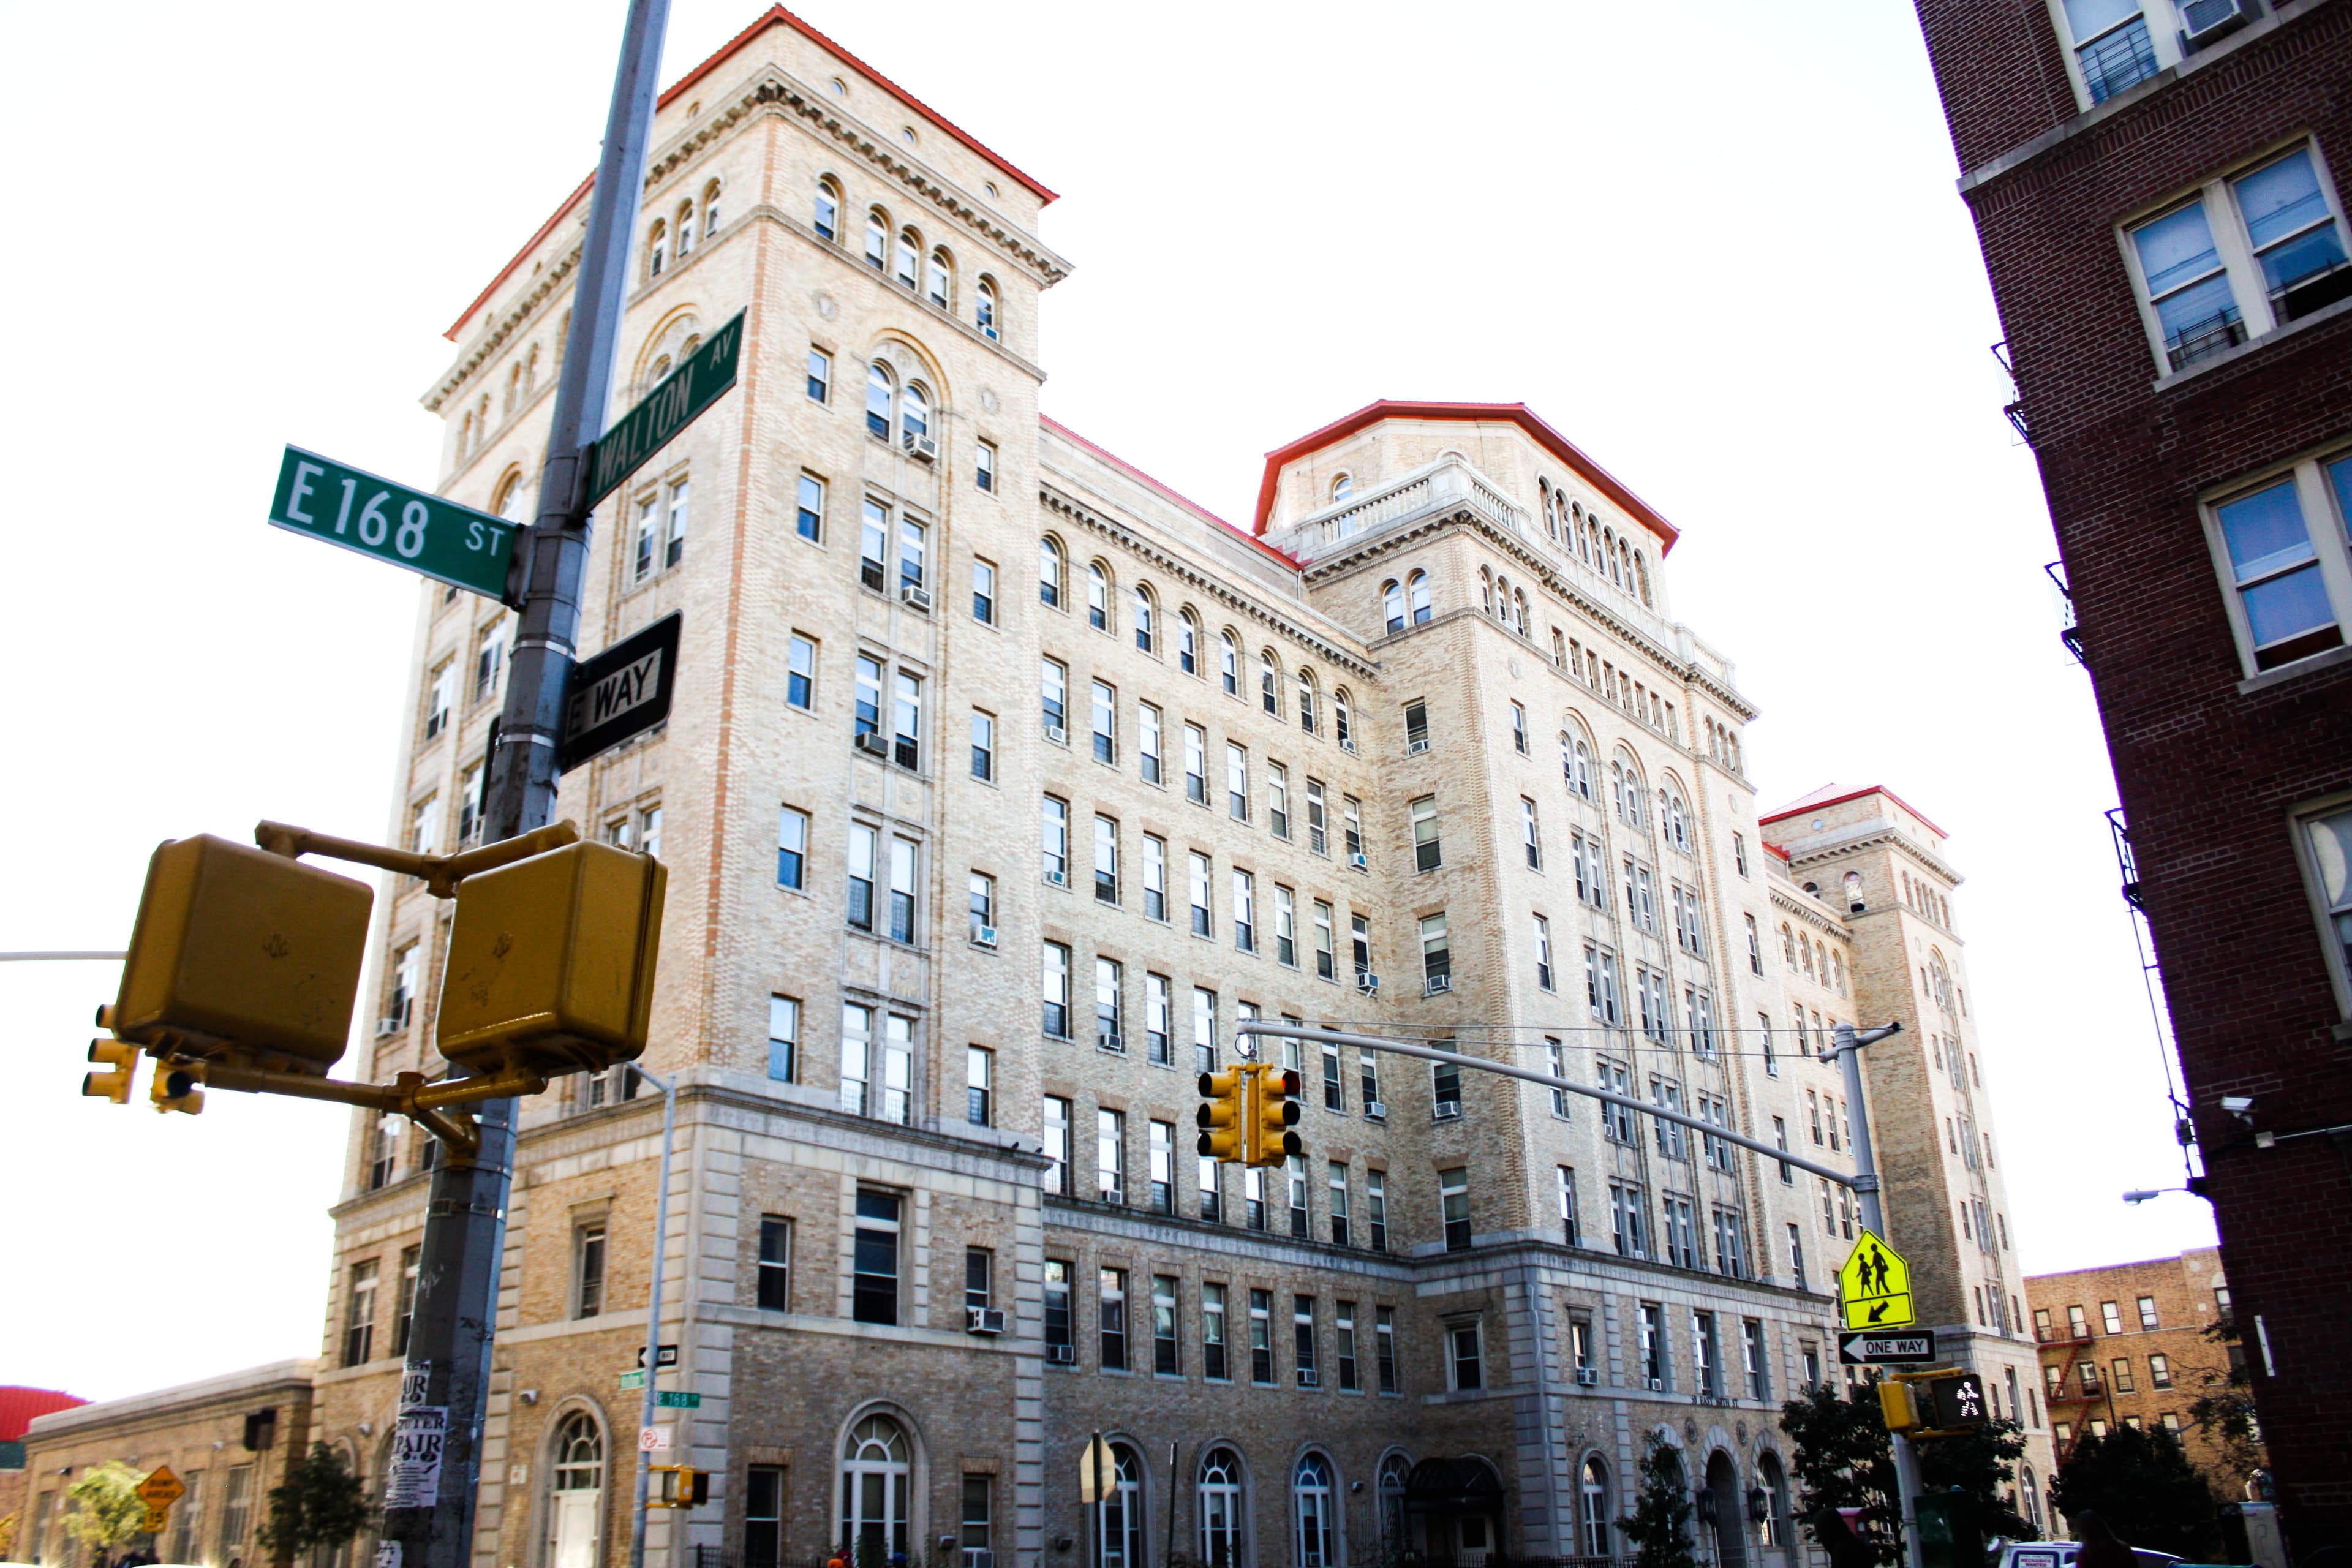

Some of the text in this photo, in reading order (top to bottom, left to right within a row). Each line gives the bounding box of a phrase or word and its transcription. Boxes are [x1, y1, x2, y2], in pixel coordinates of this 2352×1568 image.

[595, 326, 734, 492] WALTON AV
[286, 460, 505, 559] E 168 ST
[594, 657, 654, 723] WAY
[1866, 1340, 1924, 1354] ONE WAY
[669, 1393, 688, 1406] 168
[392, 1434, 442, 1454] PAIR
